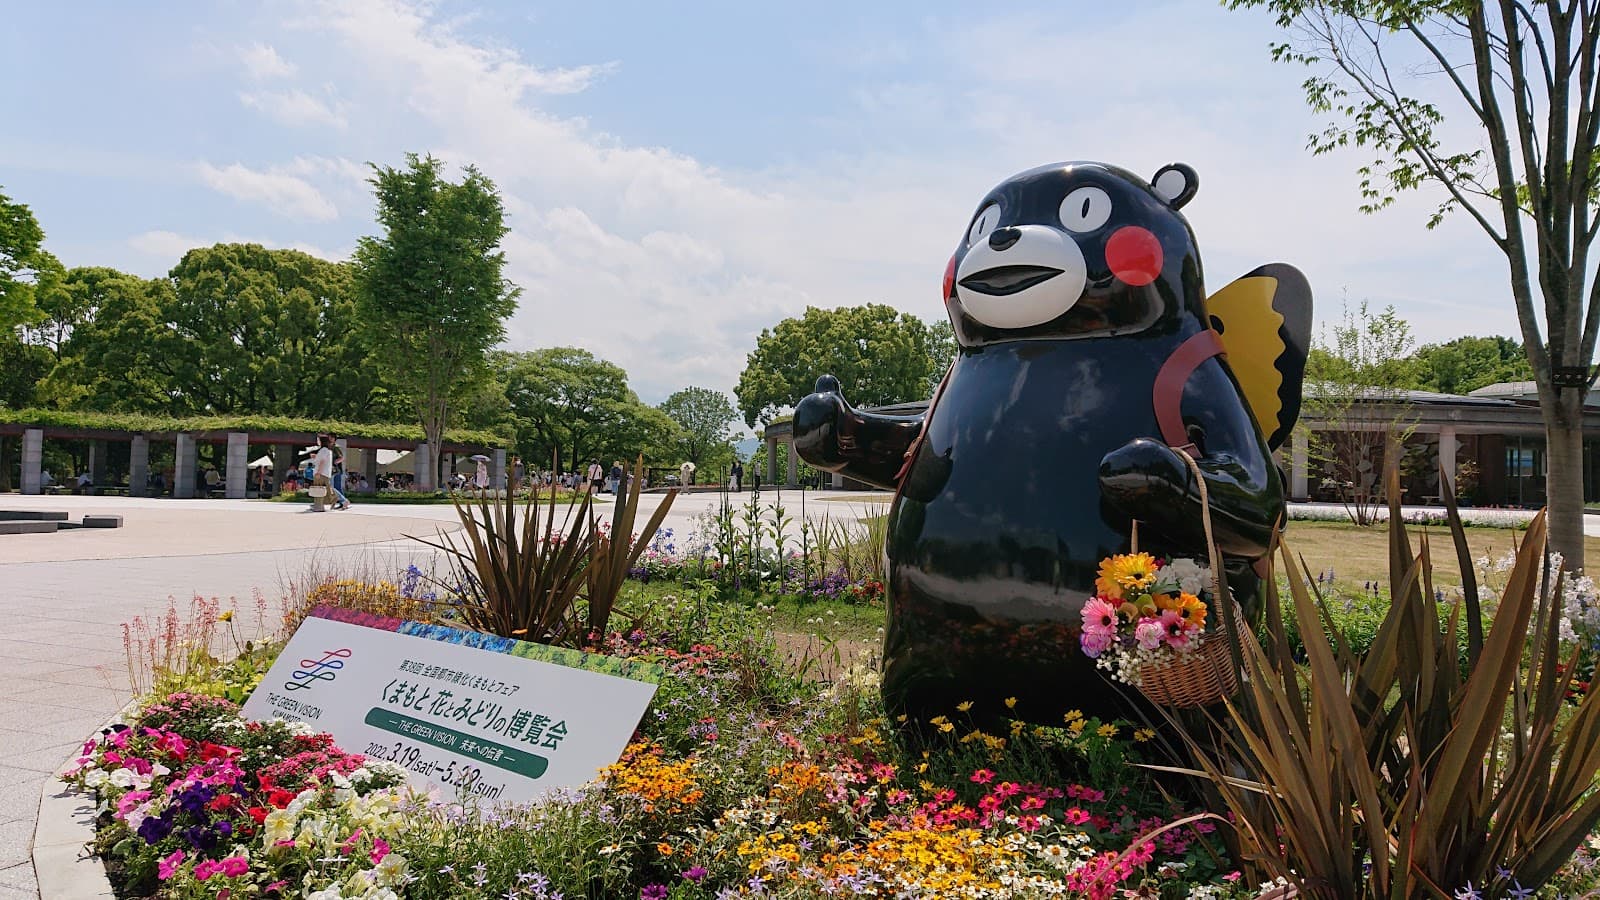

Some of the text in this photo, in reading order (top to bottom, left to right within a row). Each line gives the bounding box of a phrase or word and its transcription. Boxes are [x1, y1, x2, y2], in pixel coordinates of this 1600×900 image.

[266, 692, 323, 720] THE GREEN VISION
[398, 720, 458, 746] THE GREEN VISION
[459, 740, 504, 762] 未来への伝言
